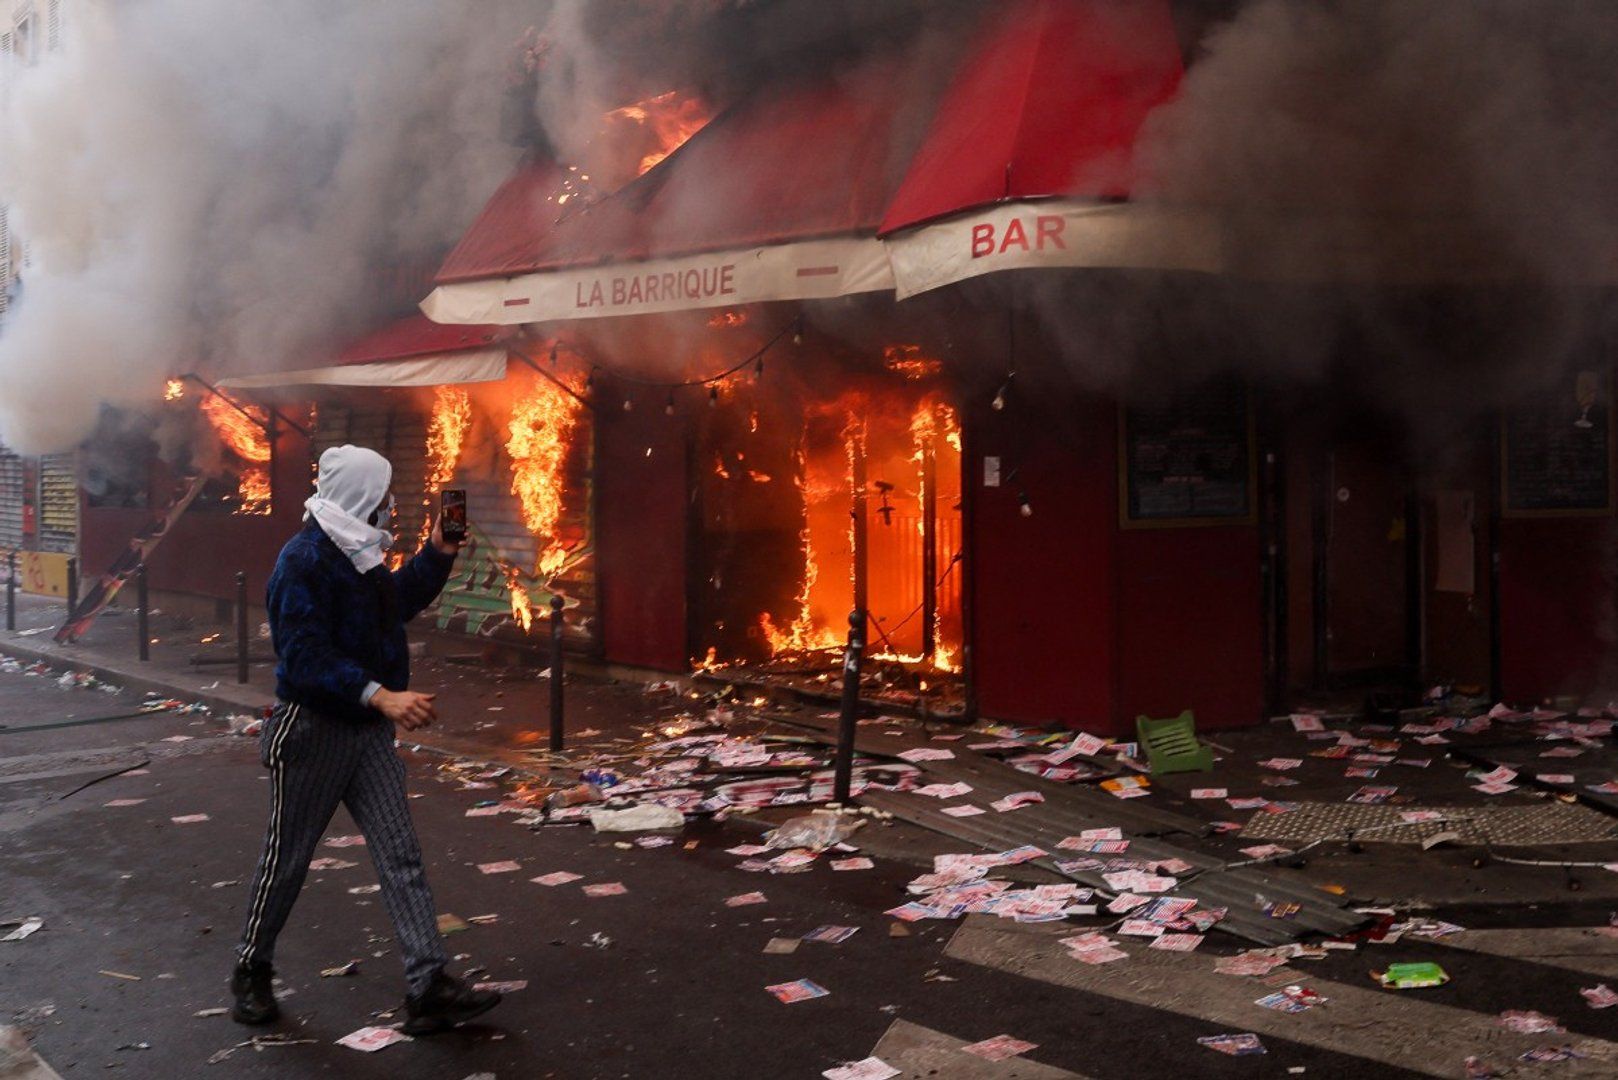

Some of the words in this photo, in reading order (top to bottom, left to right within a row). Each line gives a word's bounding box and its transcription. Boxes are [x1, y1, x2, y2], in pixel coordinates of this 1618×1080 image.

[972, 215, 1067, 259] BAR
[576, 280, 604, 308] LA
[612, 264, 736, 305] BARRIQUE
